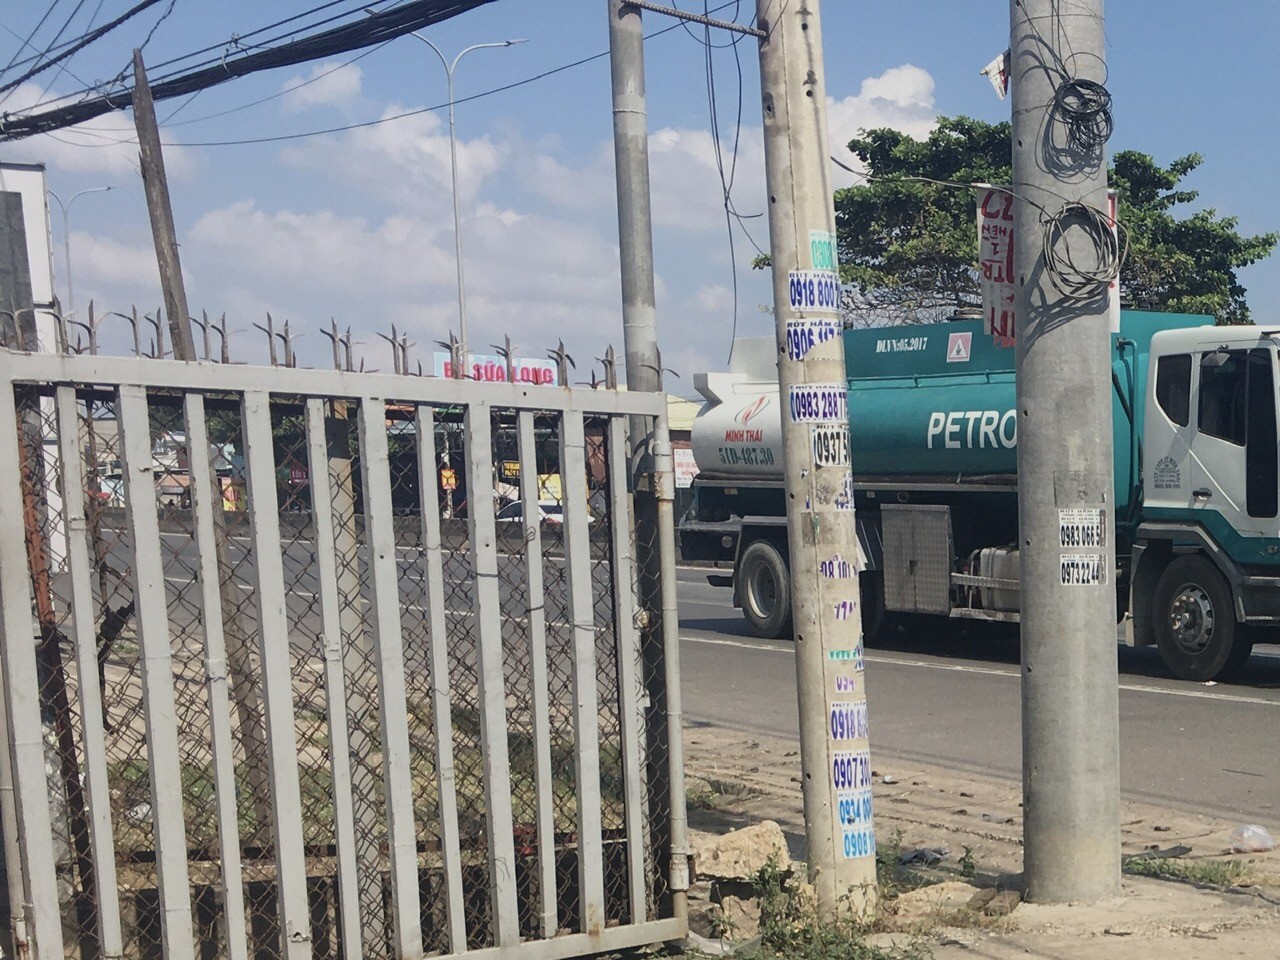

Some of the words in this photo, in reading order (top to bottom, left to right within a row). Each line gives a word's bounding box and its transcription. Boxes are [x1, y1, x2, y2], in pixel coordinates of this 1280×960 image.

[790, 279, 815, 307] 0918
[818, 279, 835, 308] 800
[795, 391, 819, 419] 0983
[821, 391, 838, 418] 288
[725, 429, 745, 443] MINH
[926, 408, 1017, 450] PETRO
[817, 432, 840, 463] 0937
[1060, 525, 1080, 547] 0983
[1081, 525, 1095, 547] 066
[831, 709, 856, 740] 0918
[834, 757, 858, 789] 0907
[844, 832, 868, 857] 0908
